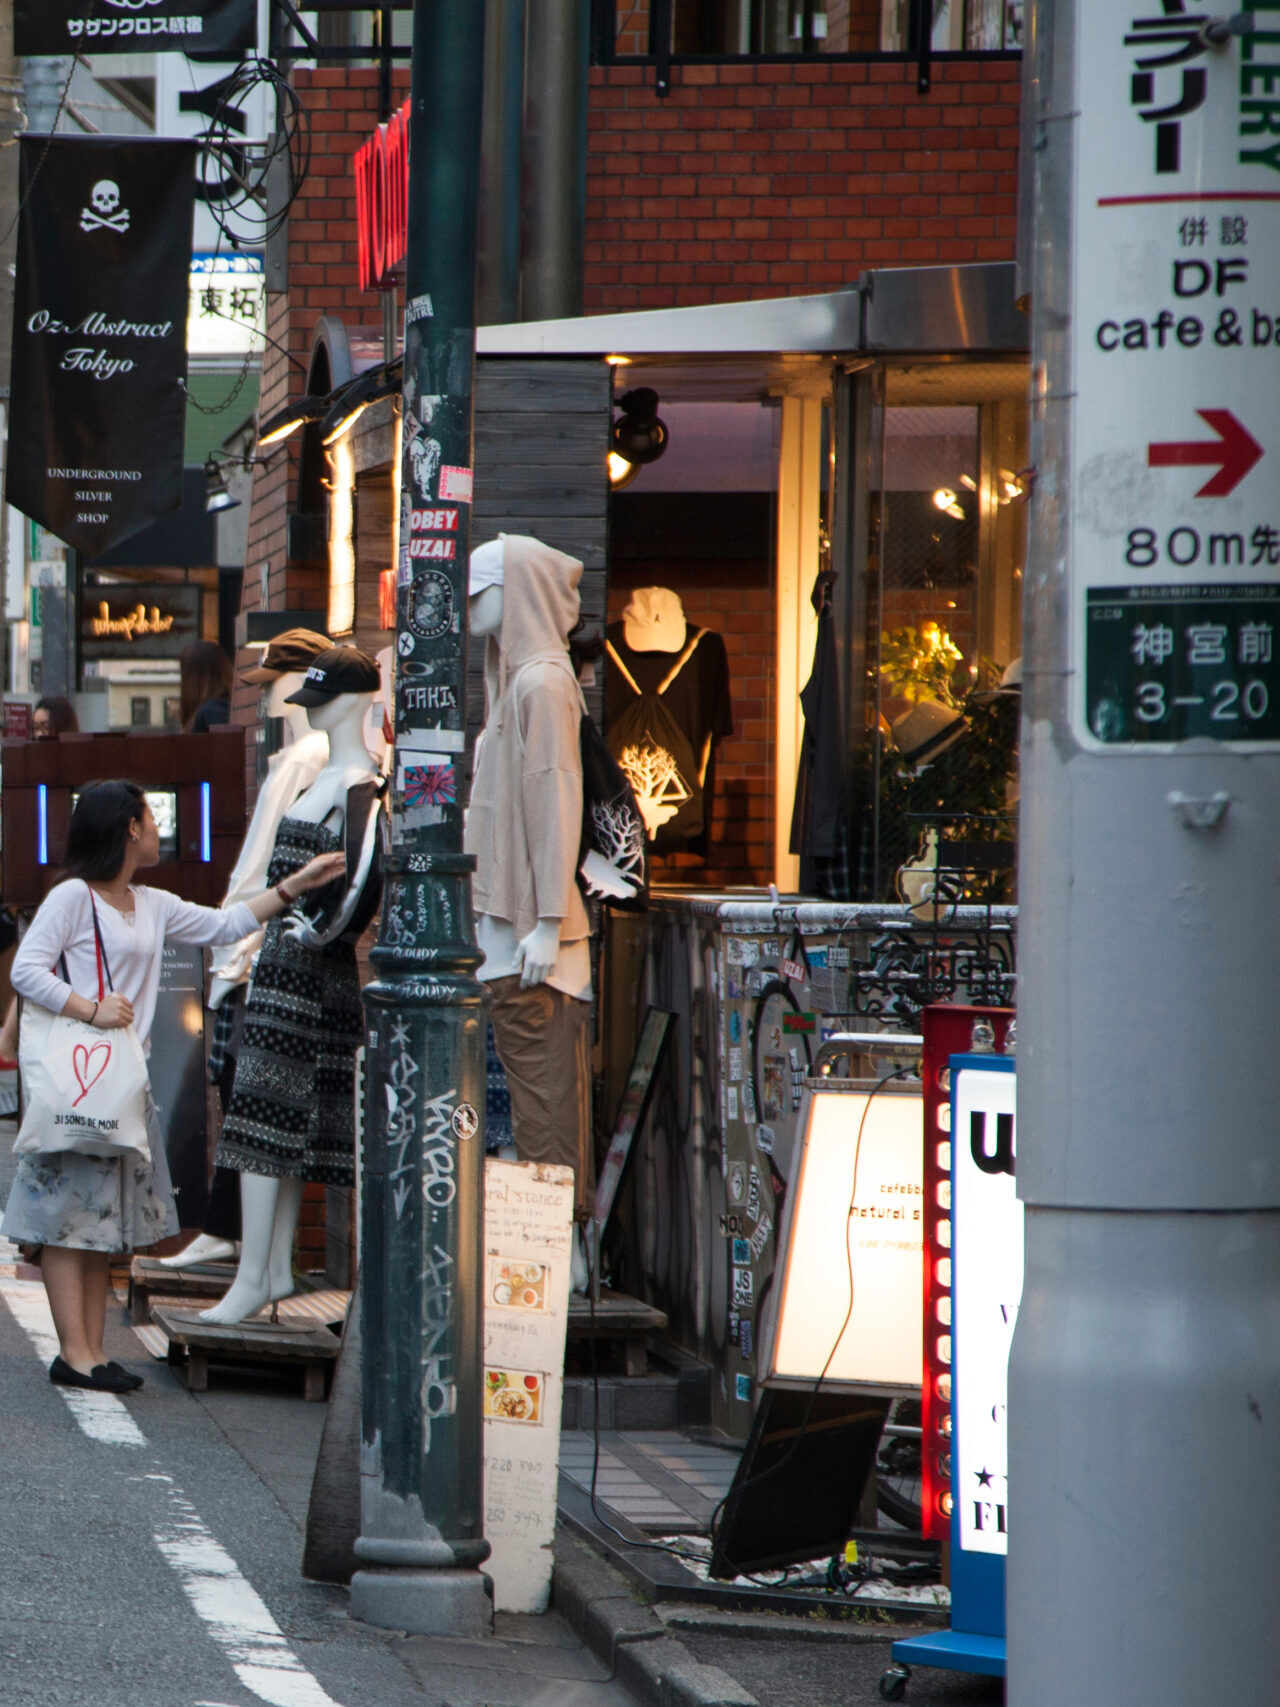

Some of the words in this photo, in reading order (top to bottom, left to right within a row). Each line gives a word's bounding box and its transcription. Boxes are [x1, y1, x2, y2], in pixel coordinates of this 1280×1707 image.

[1123, 0, 1208, 174] ラリー
[1179, 216, 1248, 246] 併設
[1173, 258, 1249, 298] DF
[190, 286, 257, 319] 東拓
[27, 309, 65, 334] Oz
[64, 311, 173, 338] Abstract
[59, 347, 138, 381] Tokyo
[47, 467, 142, 481] UNDERGROUND
[75, 490, 113, 502] SILVER
[76, 513, 109, 524] SHOP
[411, 510, 457, 529] OBEY
[1132, 621, 1272, 665] 神宮前
[97, 1120, 120, 1130] MODE
[849, 1205, 905, 1220] natural
